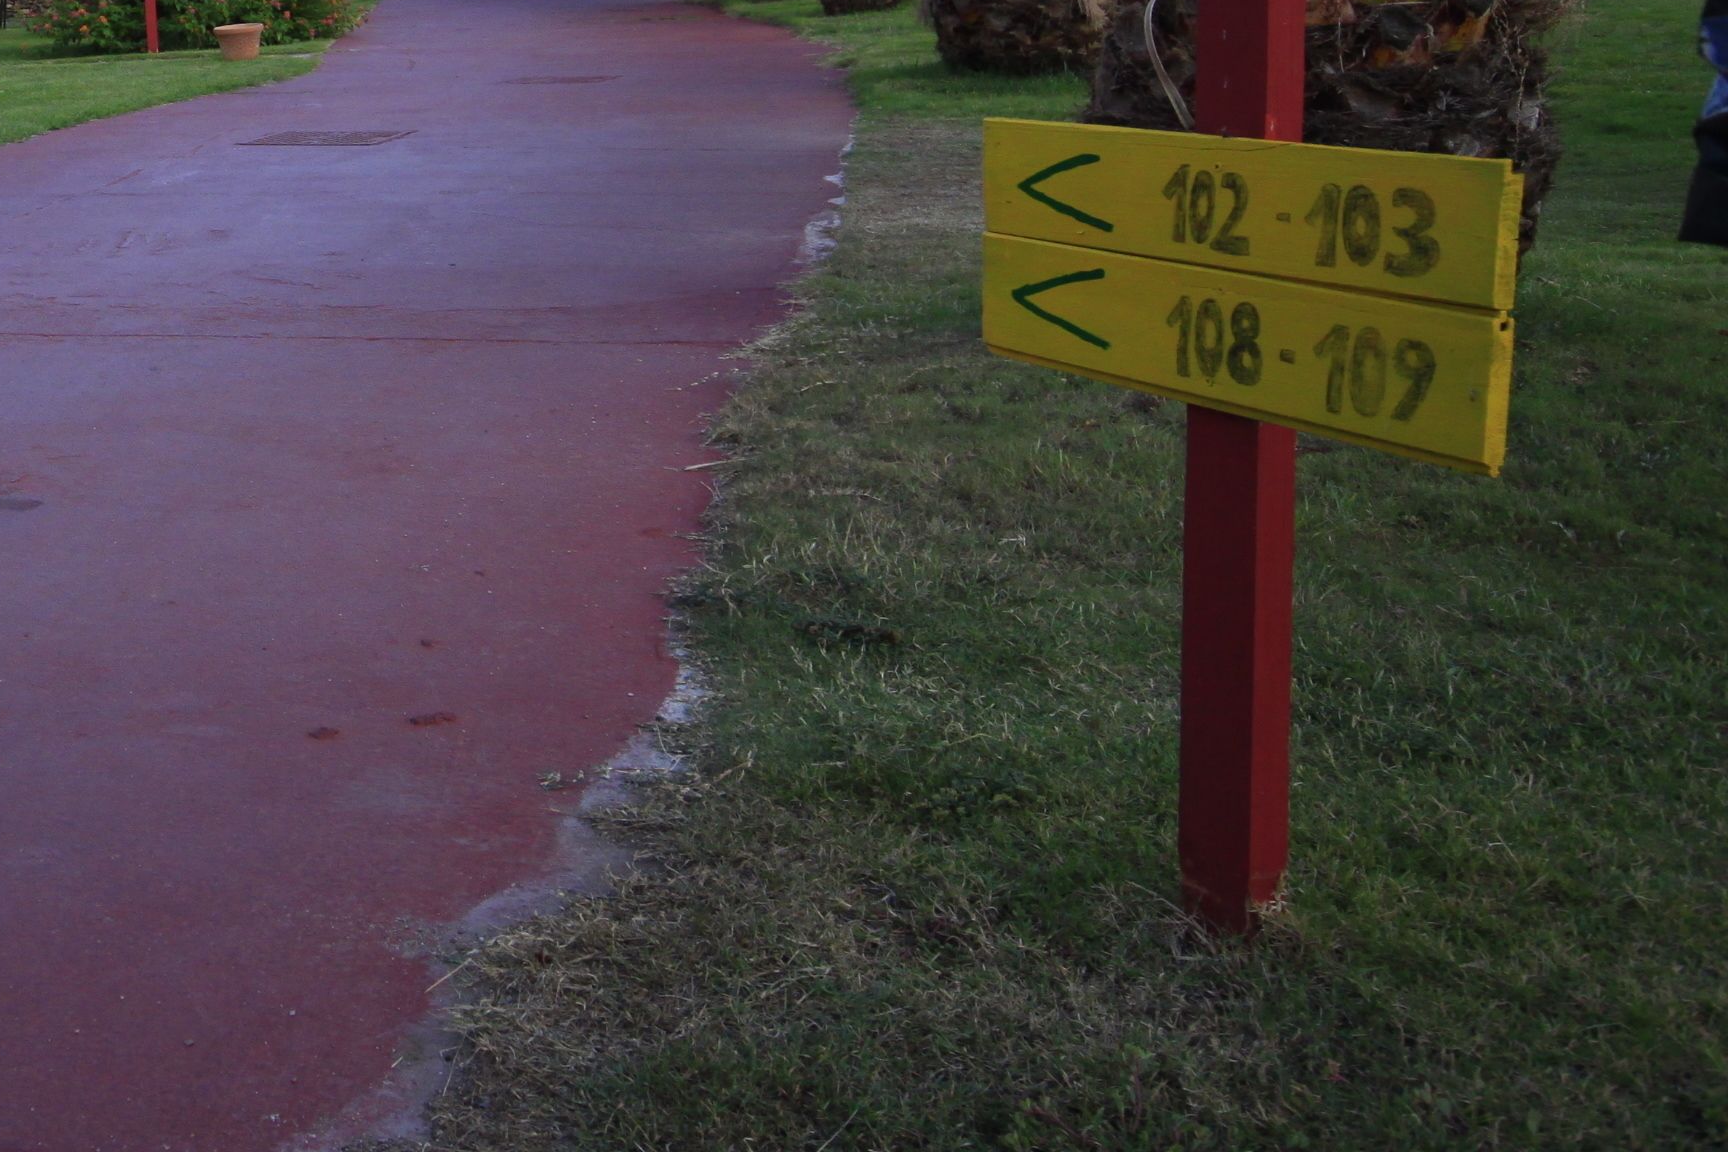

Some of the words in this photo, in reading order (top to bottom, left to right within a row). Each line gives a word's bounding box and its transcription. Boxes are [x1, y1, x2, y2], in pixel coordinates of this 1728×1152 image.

[1161, 163, 1251, 257] 102
[1303, 183, 1442, 278] 103
[1166, 295, 1263, 387] 108
[1312, 324, 1437, 422] 109
